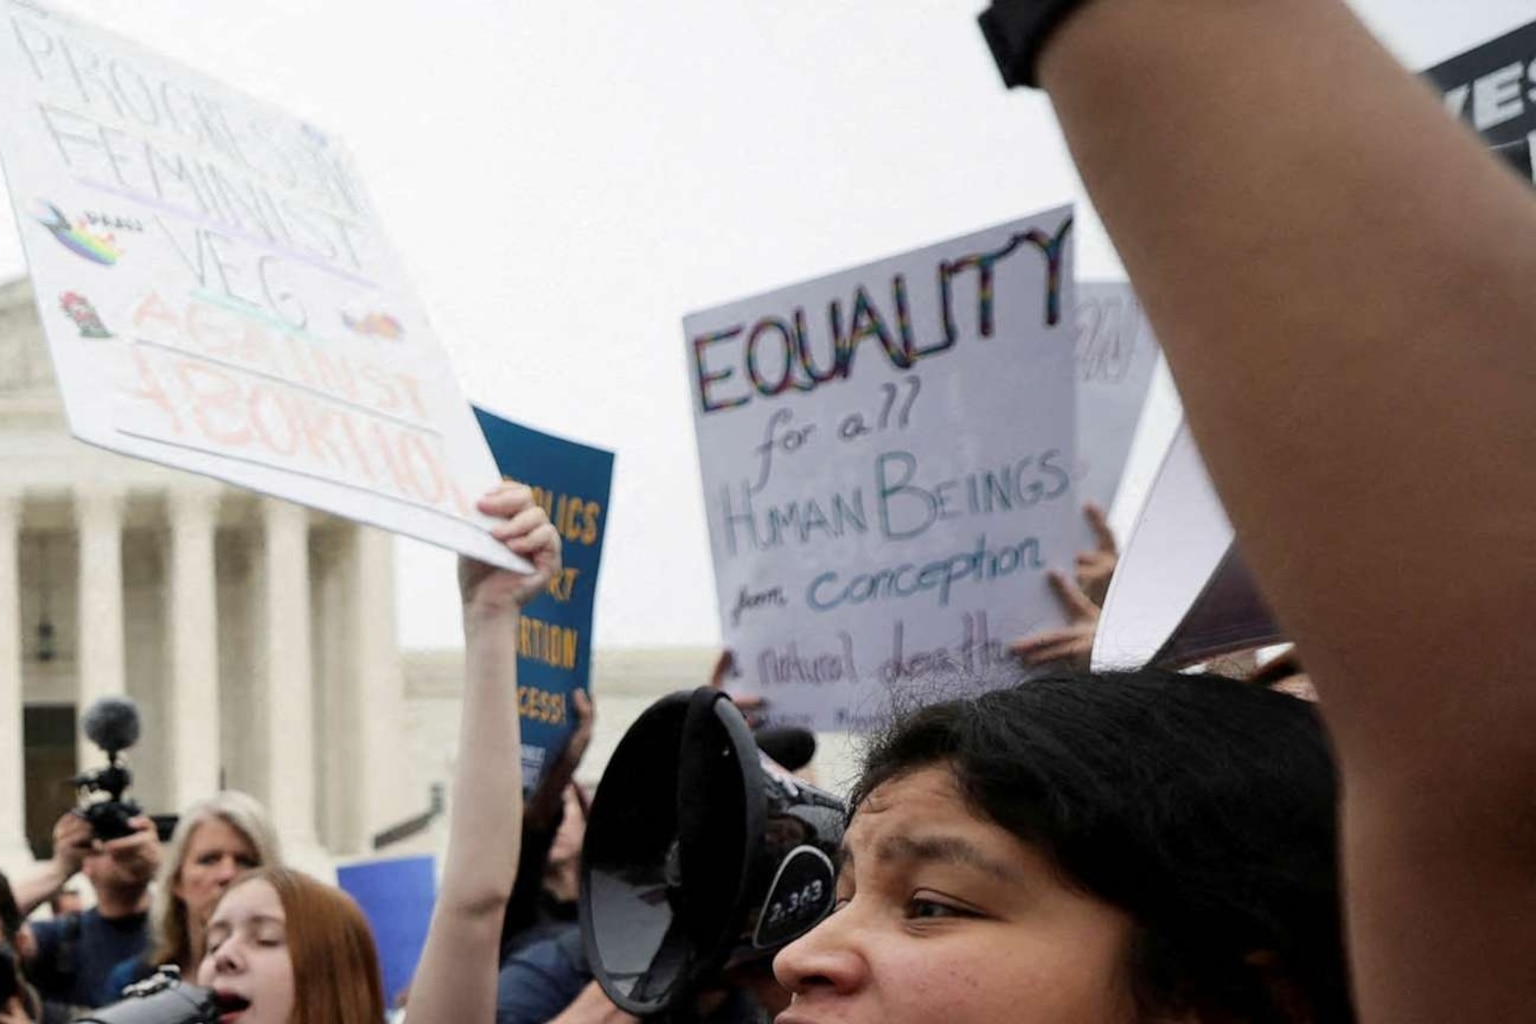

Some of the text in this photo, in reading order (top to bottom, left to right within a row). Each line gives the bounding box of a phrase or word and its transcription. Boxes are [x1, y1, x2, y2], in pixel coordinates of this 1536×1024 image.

[37, 101, 360, 269] FEMINIST
[692, 214, 1073, 415] EQUALITY
[752, 374, 922, 492] for all
[874, 448, 1071, 543] BEINGS
[517, 687, 566, 726] CESS!
